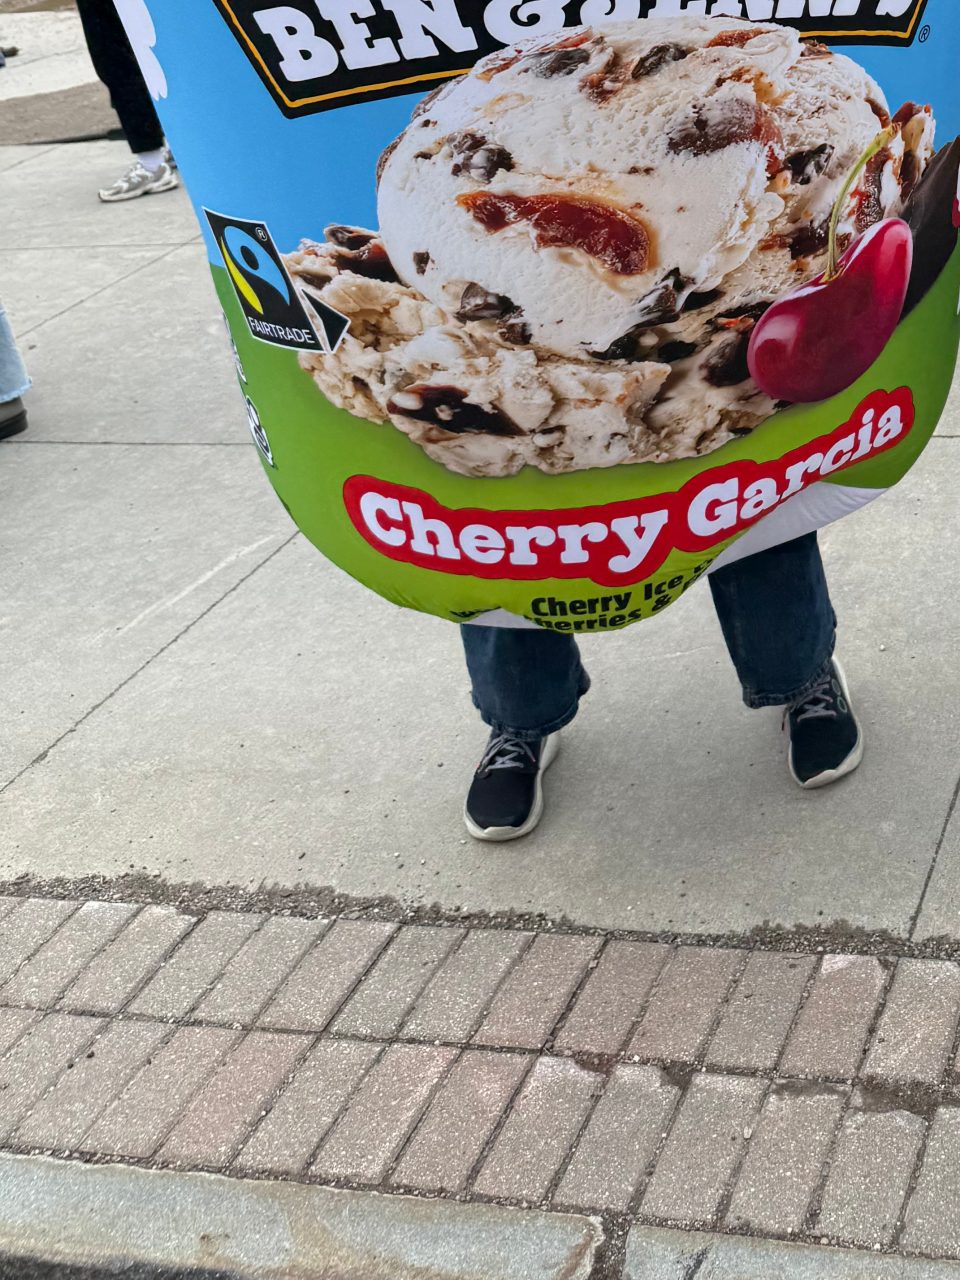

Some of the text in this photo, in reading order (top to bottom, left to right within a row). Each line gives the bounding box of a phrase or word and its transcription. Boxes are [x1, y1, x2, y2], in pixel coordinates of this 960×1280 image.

[247, 316, 316, 344] FAIRTRADE
[360, 404, 904, 574] Cherry Garcia
[531, 591, 633, 618] Cherry
[643, 574, 684, 601] Ice
